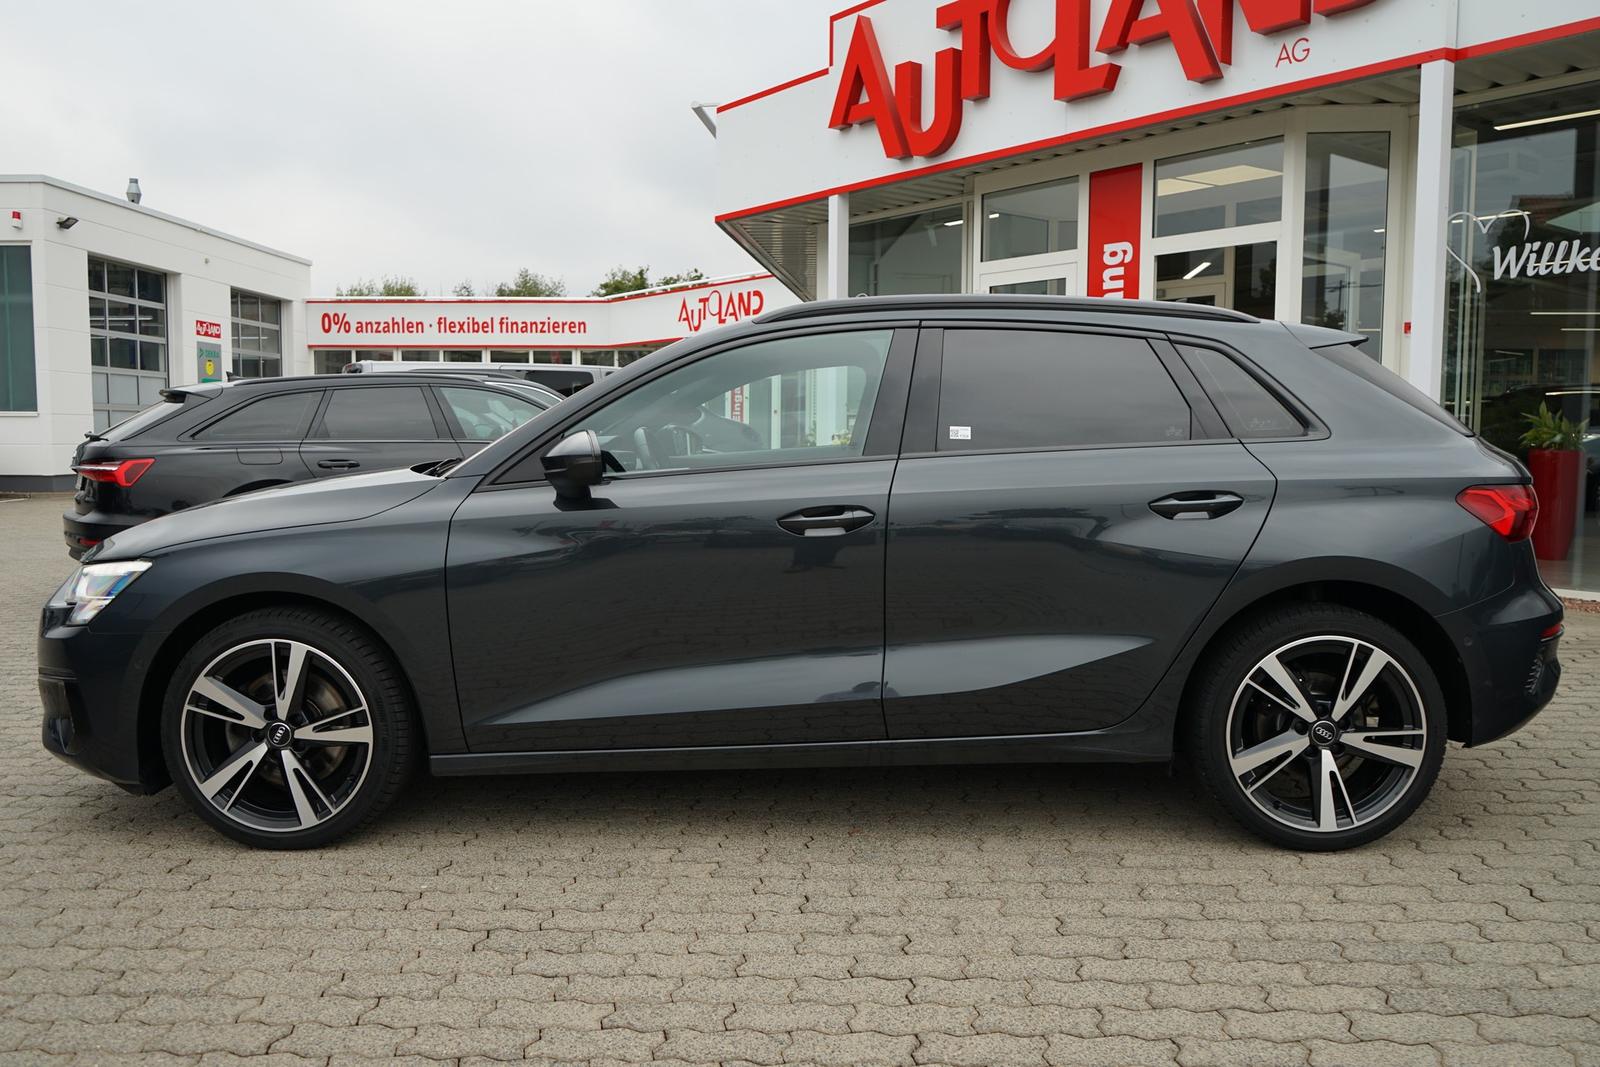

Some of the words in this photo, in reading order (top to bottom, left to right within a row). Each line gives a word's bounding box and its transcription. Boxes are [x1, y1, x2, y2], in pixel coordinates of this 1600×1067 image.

[1275, 37, 1311, 68] AG
[321, 312, 351, 334] 0%
[355, 317, 424, 334] anzahlen
[437, 317, 494, 334] flexibel
[499, 317, 587, 334] finanzieren
[678, 290, 764, 332] AUTOLAND
